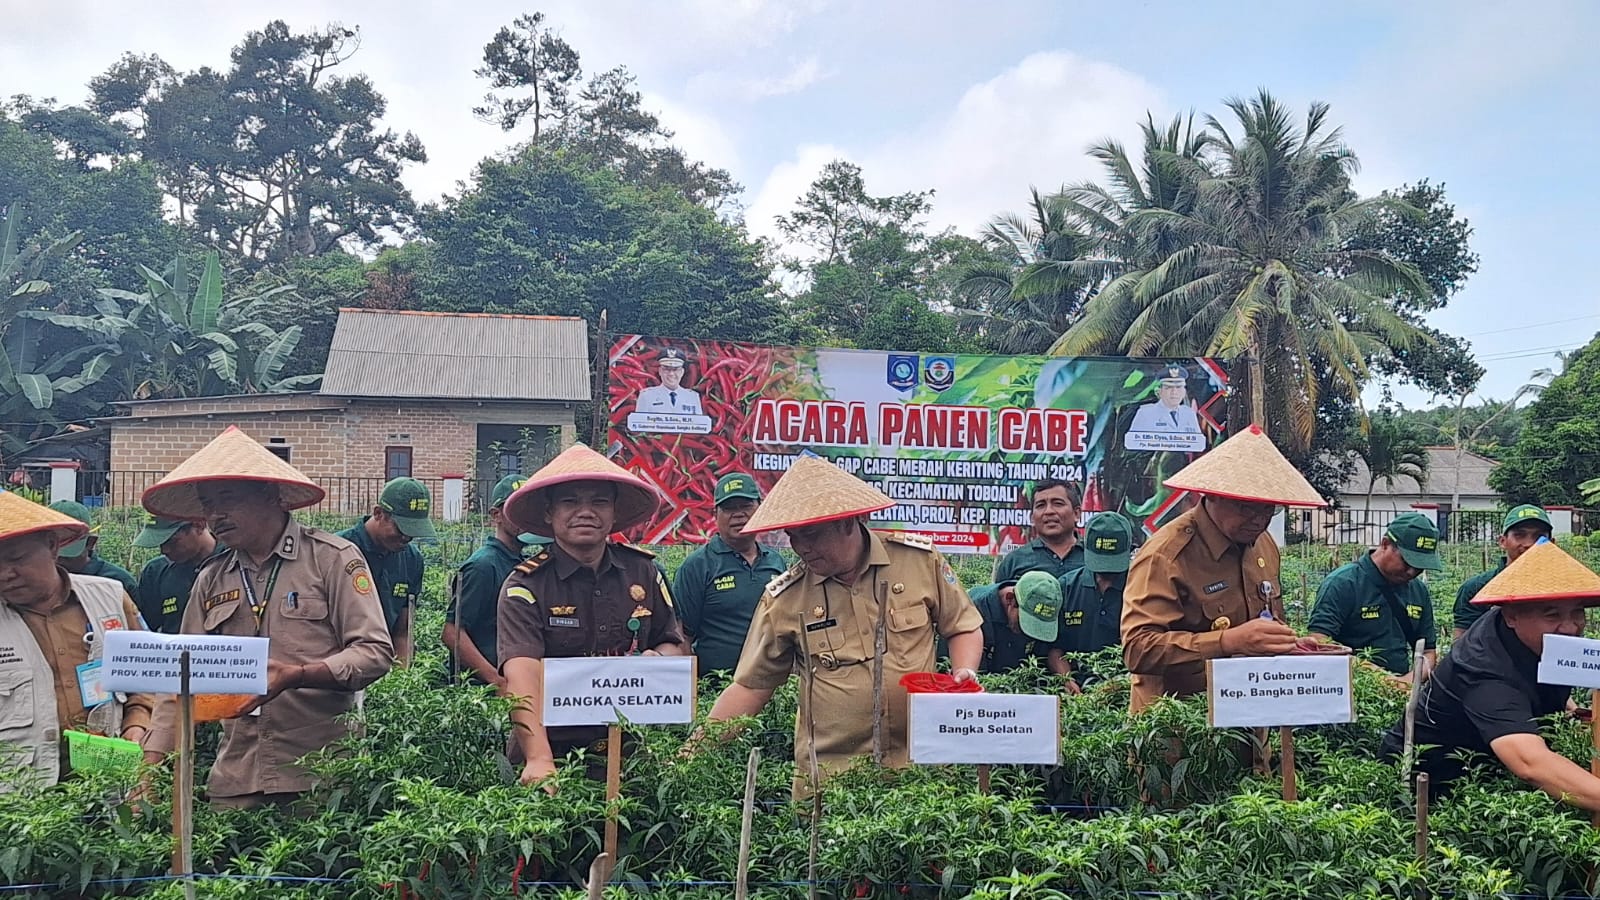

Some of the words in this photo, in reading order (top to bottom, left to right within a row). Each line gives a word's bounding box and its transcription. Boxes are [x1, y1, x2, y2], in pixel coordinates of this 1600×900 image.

[754, 401, 870, 445] ACARA
[880, 404, 991, 450] PANEN
[999, 408, 1087, 454] CABE
[864, 457, 897, 475] CABE
[900, 459, 944, 477] MERAH
[946, 462, 1004, 479] KERITING
[1007, 463, 1047, 480] TAHUN
[1051, 465, 1083, 481] 2024
[889, 482, 964, 501] KECAMATAN
[967, 485, 1018, 502] TOBOALI
[870, 504, 919, 524] ELATAN,
[922, 506, 957, 523] PROV.
[960, 507, 987, 524] KEP.
[990, 508, 1031, 526] BANGK
[952, 534, 974, 543] 2024
[130, 642, 162, 650] BADAN
[165, 643, 242, 652] STANDARDISASI
[112, 655, 169, 664] INSTRUMEN
[229, 658, 258, 667] (BSIP)
[1557, 659, 1579, 668] KAB.
[111, 669, 138, 677] PROV.
[142, 669, 162, 678] KEP.
[209, 671, 257, 679] BELITUNG
[1248, 672, 1259, 683] Pj
[1263, 672, 1317, 681] Gubernur
[592, 677, 644, 688] KAJARI
[1220, 688, 1246, 699] Kep.
[1250, 687, 1294, 698] Bangka
[1297, 686, 1344, 696] Belitung
[553, 696, 613, 707] BANGKA
[618, 695, 683, 706] SELATAN
[955, 709, 974, 720] Pjs
[977, 708, 1016, 720] Bupati
[939, 724, 984, 735] Bangka
[988, 724, 1033, 734] Selatan
